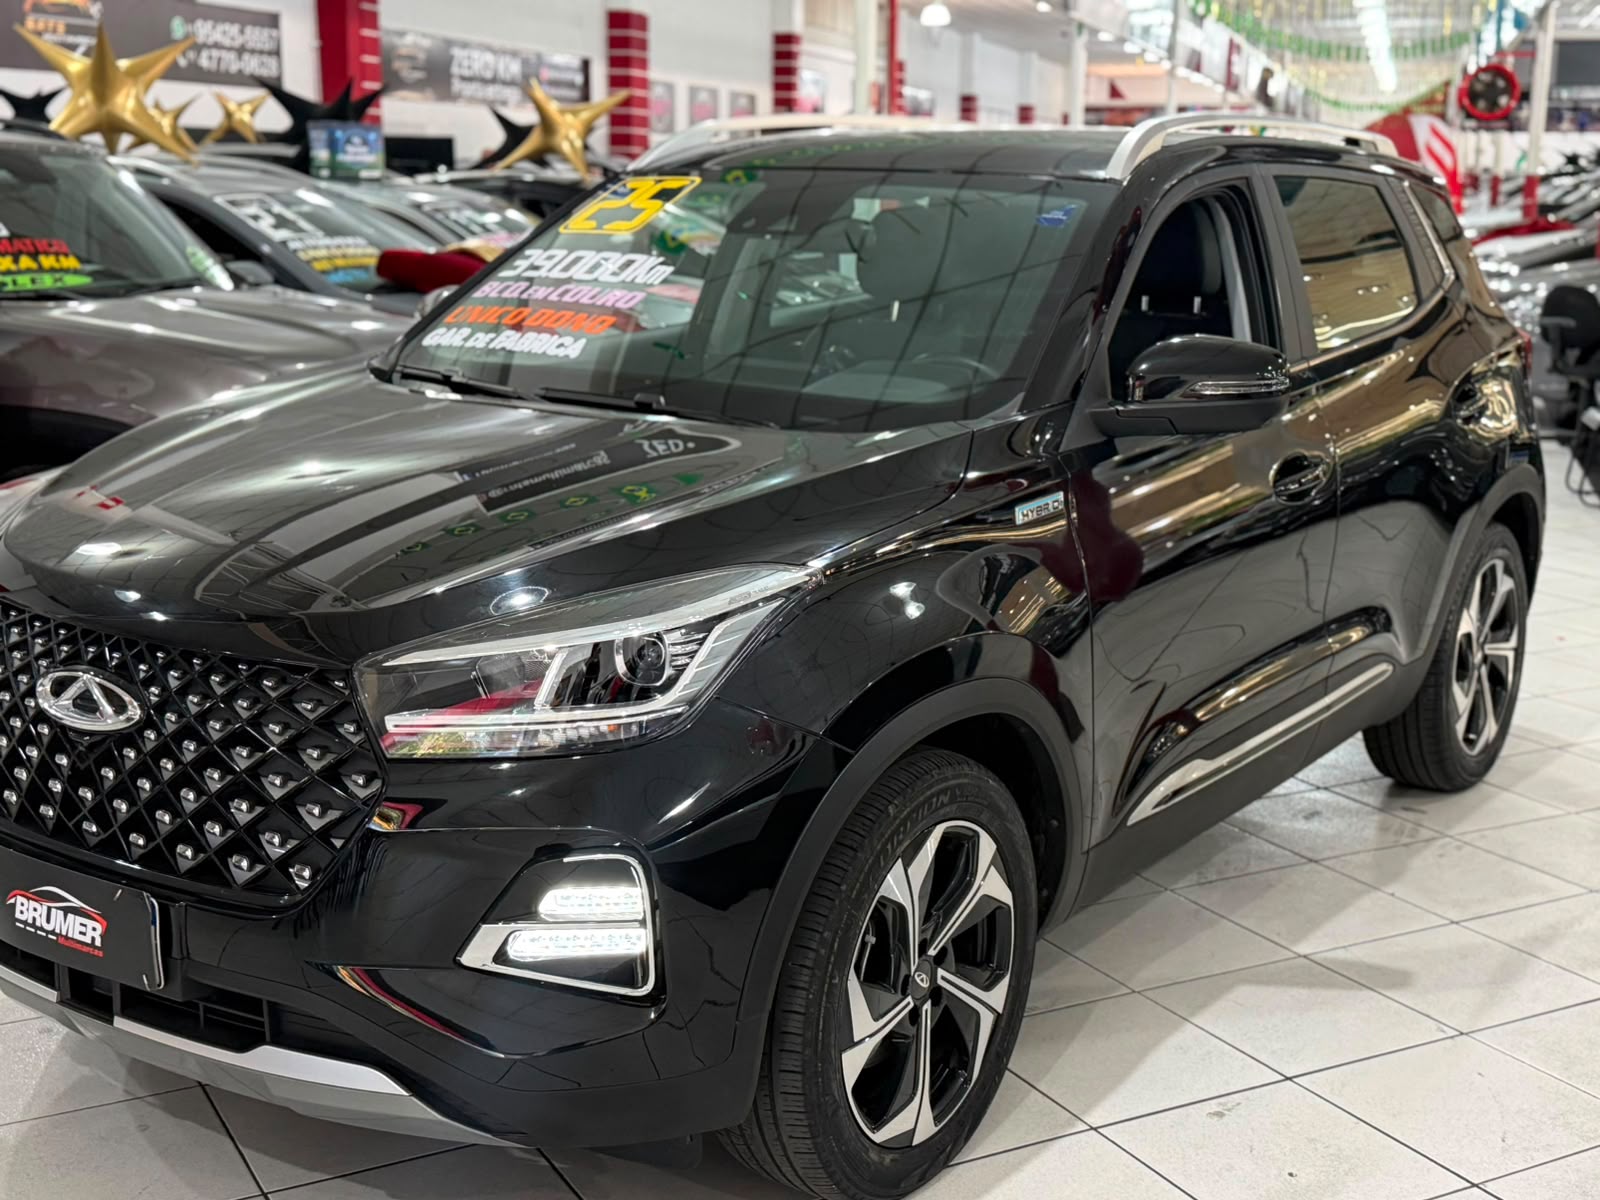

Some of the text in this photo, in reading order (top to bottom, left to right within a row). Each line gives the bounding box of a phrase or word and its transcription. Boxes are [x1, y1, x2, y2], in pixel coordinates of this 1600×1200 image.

[567, 179, 692, 230] 25
[549, 284, 647, 309] COURO
[522, 307, 617, 335] DONO
[464, 332, 496, 348] DE
[488, 330, 587, 359] FABRICA
[1020, 500, 1060, 518] HYBRD
[14, 894, 103, 947] BRUMER
